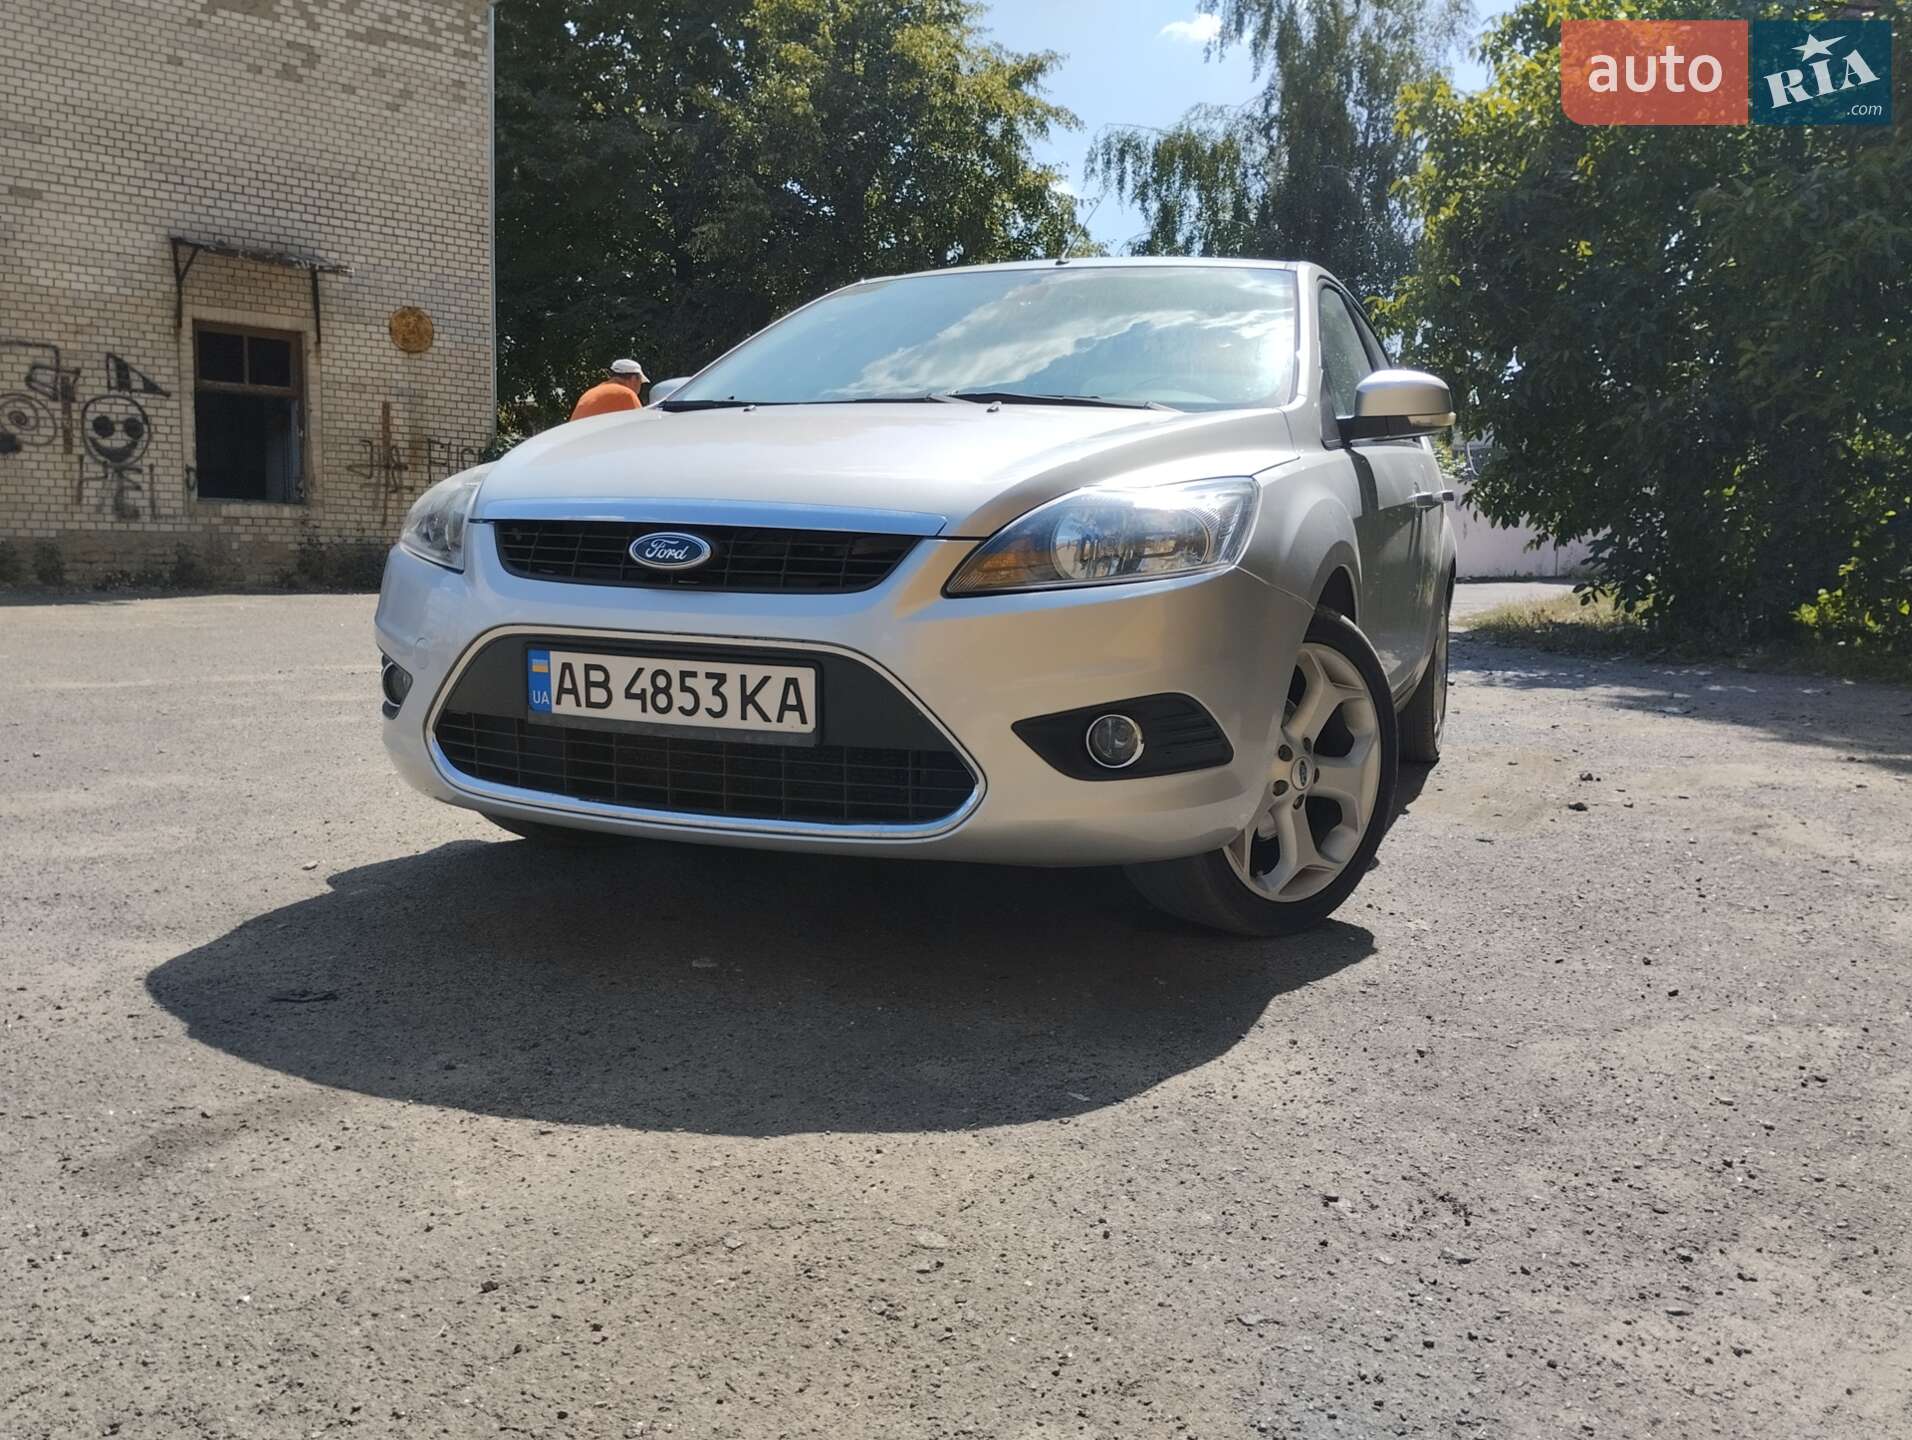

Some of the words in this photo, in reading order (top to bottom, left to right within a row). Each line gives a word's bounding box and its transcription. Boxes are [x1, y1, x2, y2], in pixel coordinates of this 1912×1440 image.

[645, 539, 688, 561] Ford
[533, 690, 549, 705] UA
[555, 661, 613, 709] AB
[624, 667, 728, 719] 4853
[740, 674, 808, 725] KA
